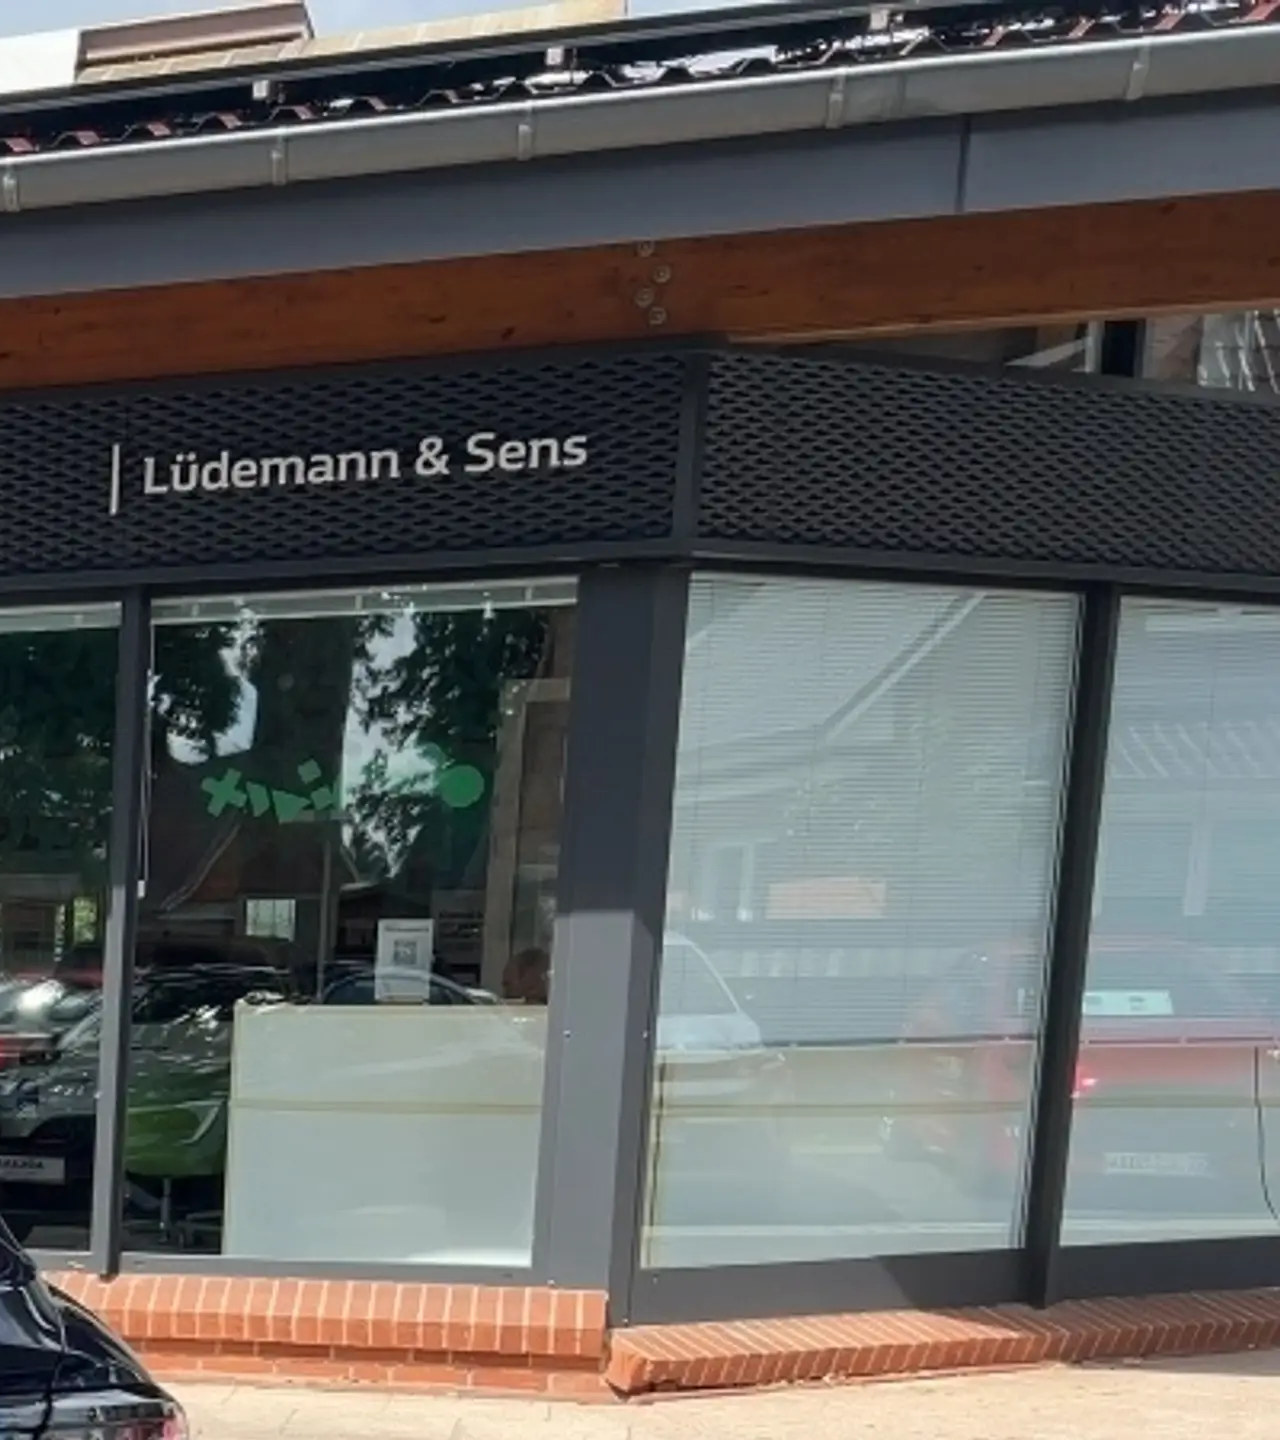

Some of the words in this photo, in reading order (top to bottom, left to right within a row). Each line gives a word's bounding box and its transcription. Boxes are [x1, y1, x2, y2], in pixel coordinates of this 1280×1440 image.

[143, 447, 400, 494] Lüdemann
[414, 436, 450, 476] &
[464, 431, 589, 473] Sens
